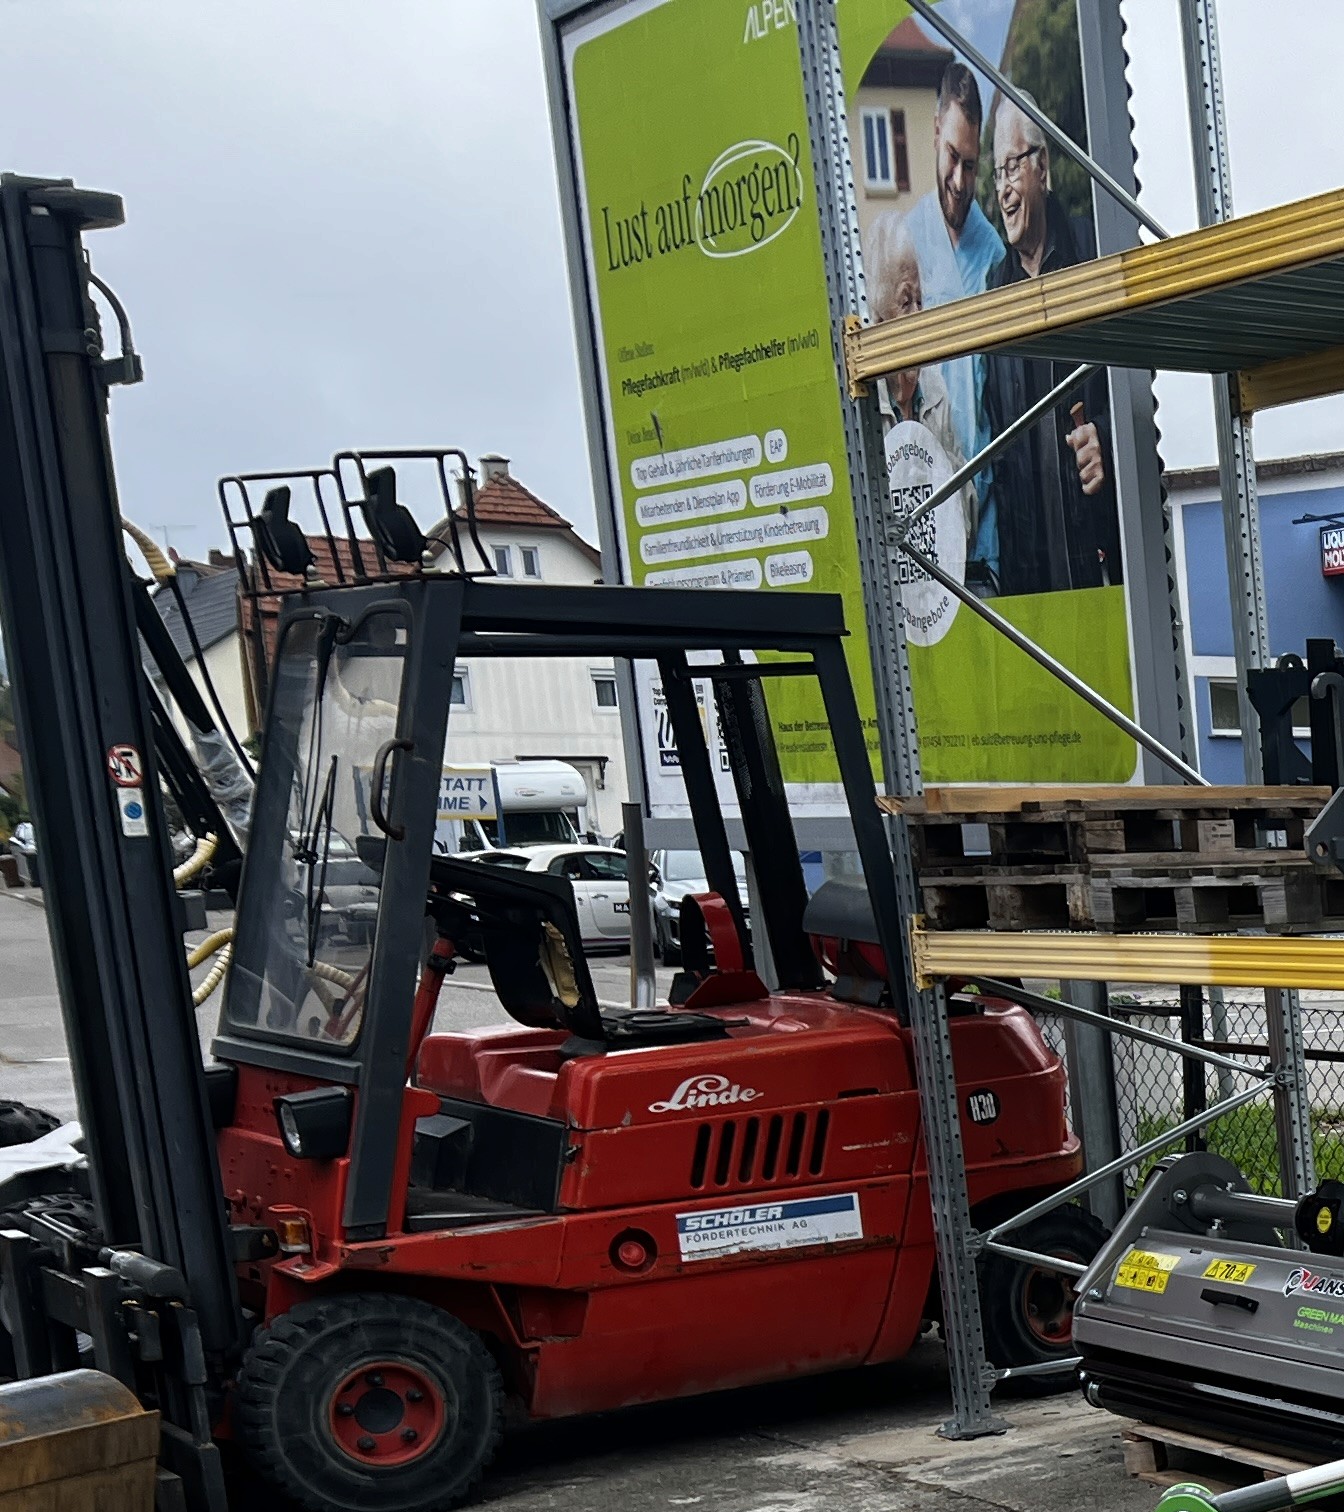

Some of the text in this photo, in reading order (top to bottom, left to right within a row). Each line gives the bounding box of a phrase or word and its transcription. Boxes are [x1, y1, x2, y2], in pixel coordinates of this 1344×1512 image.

[602, 132, 802, 271] Lust auf morgen?
[622, 366, 681, 397] Pflegefachkraft
[711, 358, 719, 373] &
[719, 338, 787, 372] Pflegefachhelfer
[769, 438, 784, 455] EAP
[887, 440, 934, 476] obangebote
[648, 461, 668, 480] Gehalt
[727, 489, 740, 508] App
[754, 472, 828, 499] Förderung E-Mobilität
[770, 559, 807, 580] Bikeleasing
[902, 594, 950, 633] obangebote
[648, 1074, 764, 1113] Linde
[969, 1093, 997, 1121] H30
[685, 1206, 783, 1231] SCHÖLER
[686, 1219, 808, 1244] FÖRDERTECHNIK AG
